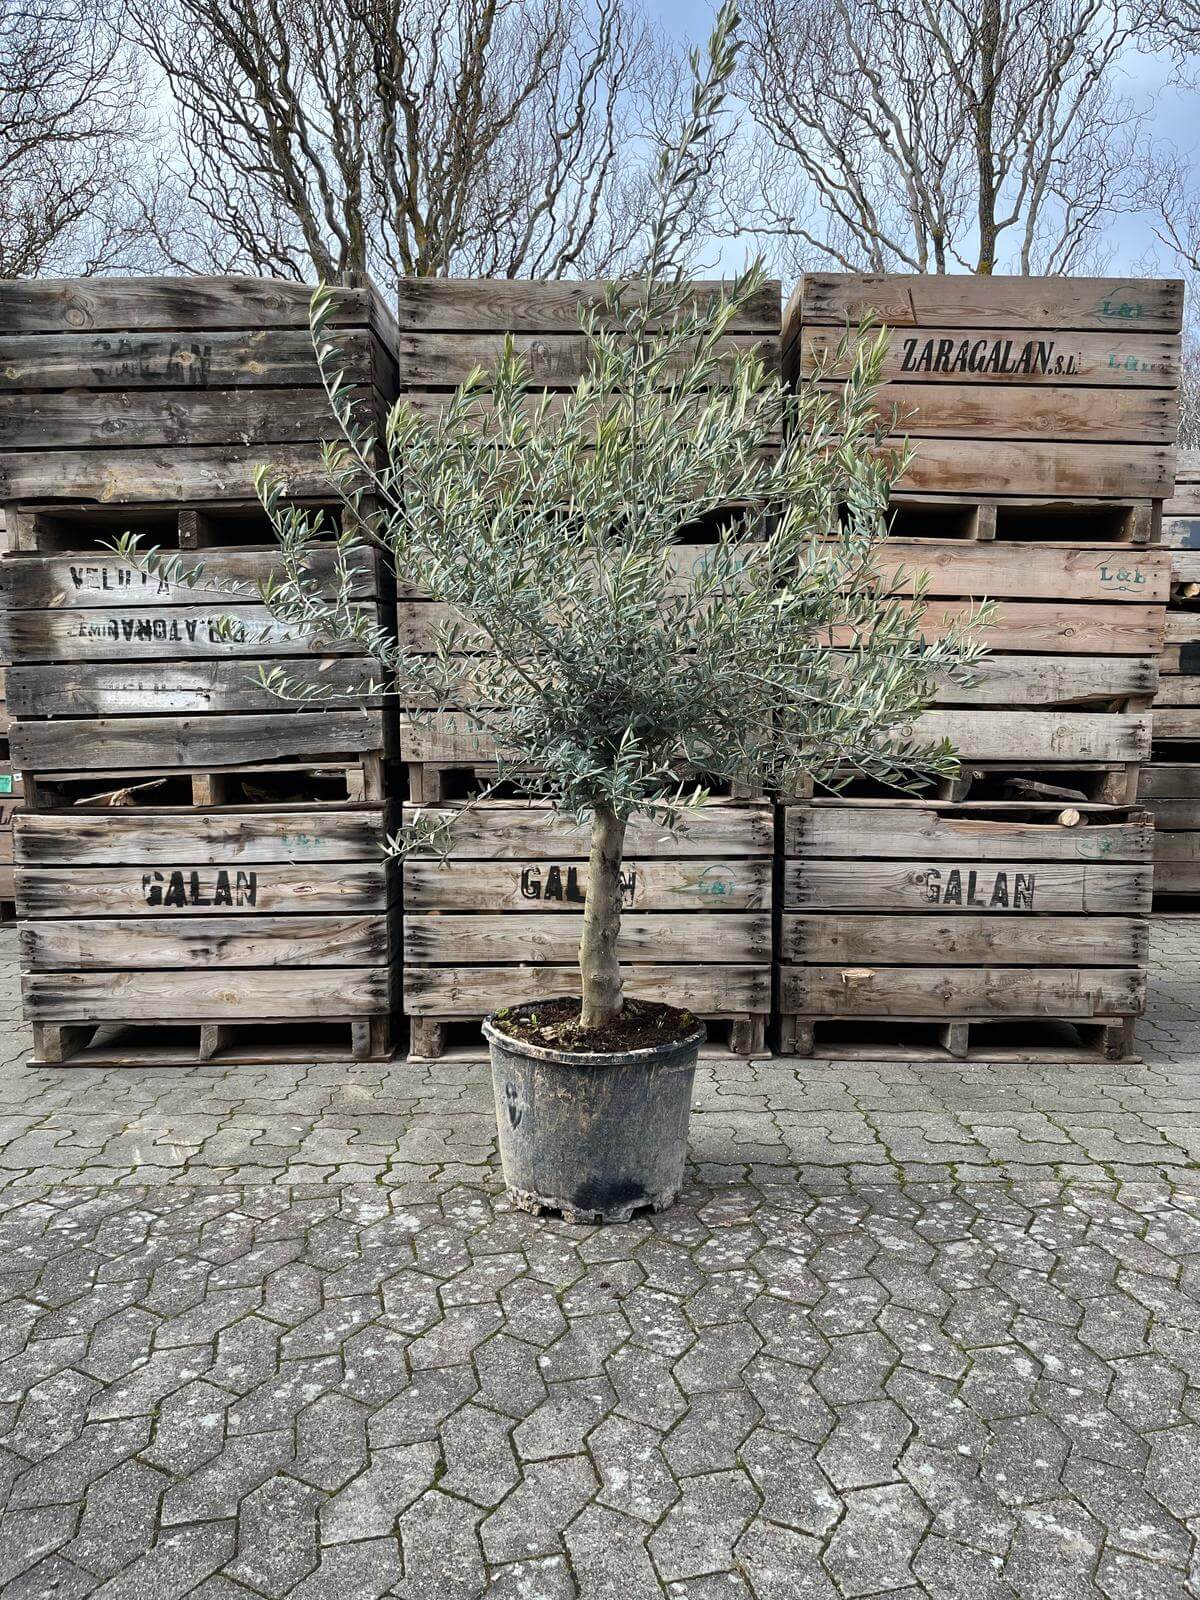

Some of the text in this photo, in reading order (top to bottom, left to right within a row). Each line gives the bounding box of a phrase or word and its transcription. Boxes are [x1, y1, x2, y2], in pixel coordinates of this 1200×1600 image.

[142, 870, 257, 908] GALAN
[521, 865, 637, 907] GALN
[926, 868, 1036, 910] GALAN
